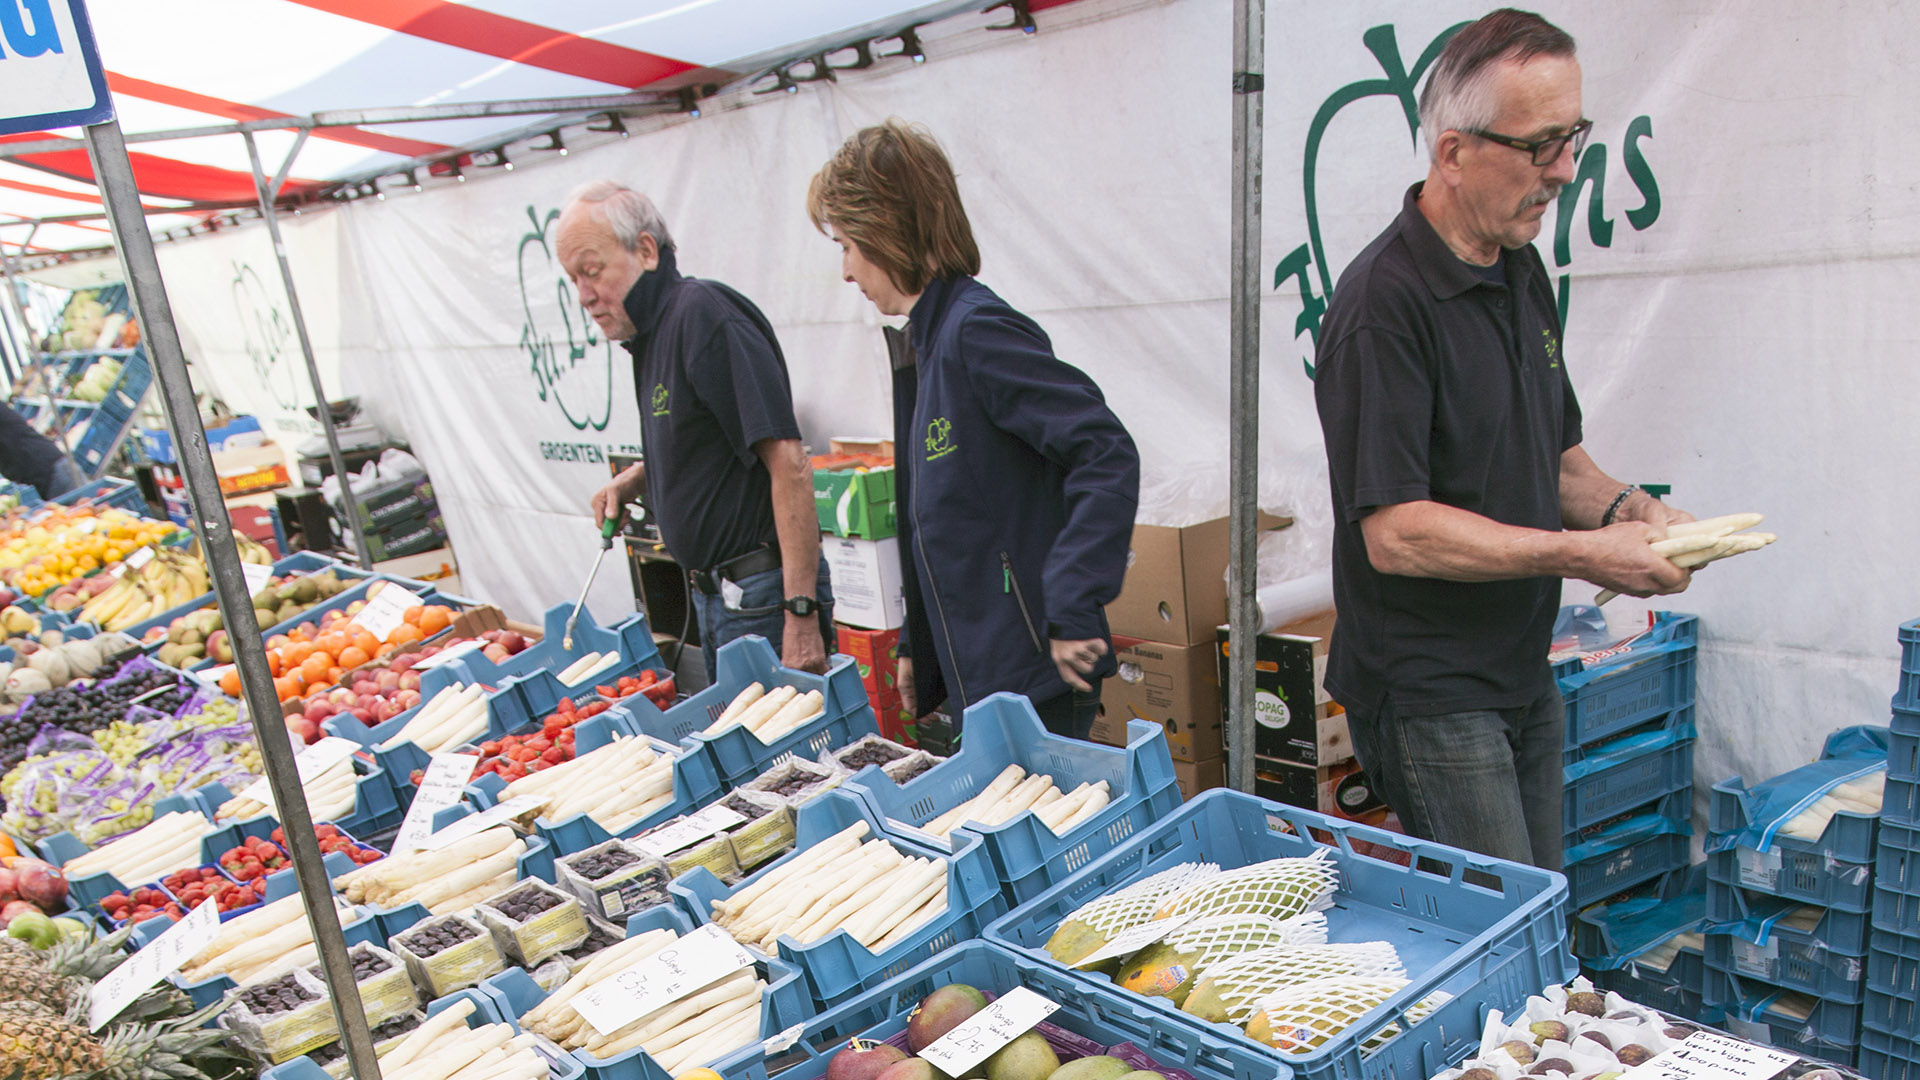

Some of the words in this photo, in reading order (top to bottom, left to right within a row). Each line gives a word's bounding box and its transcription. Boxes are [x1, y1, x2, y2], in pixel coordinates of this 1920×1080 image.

[539, 442, 605, 463] GROENTEN
[1134, 646, 1163, 660] Bananas
[985, 1003, 1015, 1026] Mango
